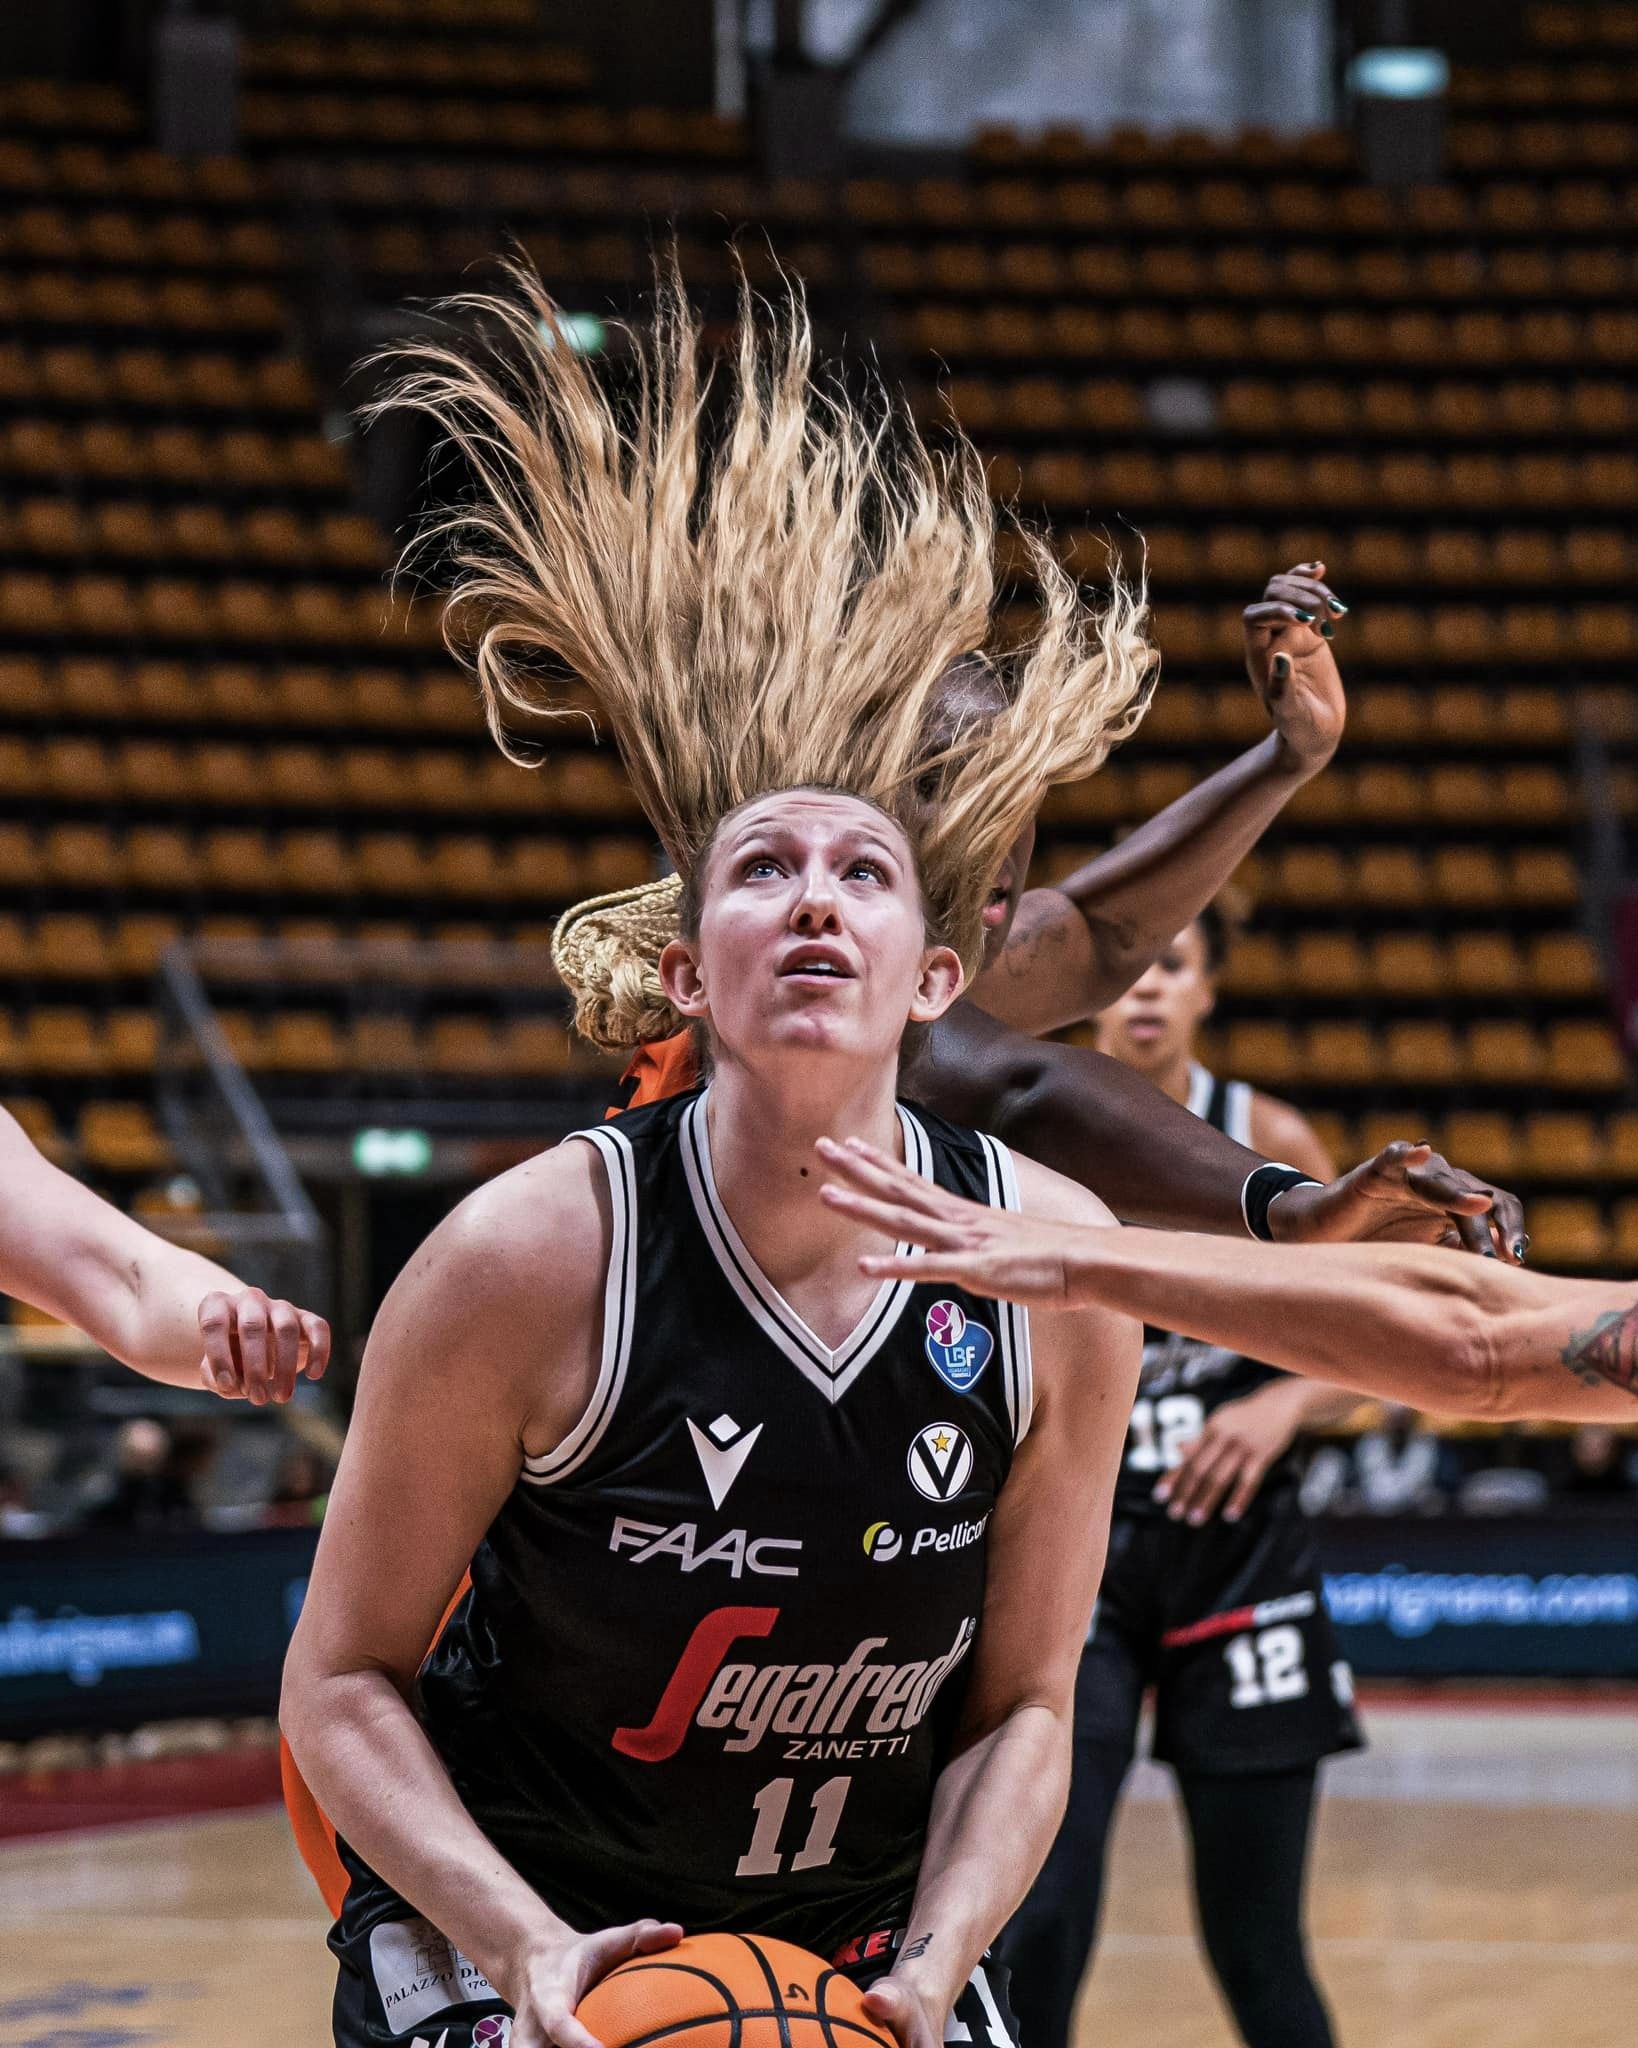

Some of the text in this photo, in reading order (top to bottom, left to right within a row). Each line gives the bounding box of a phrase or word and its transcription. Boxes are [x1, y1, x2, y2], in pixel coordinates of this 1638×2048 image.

[944, 1345, 976, 1368] LBF
[1127, 1394, 1204, 1472] 12
[608, 1516, 802, 1578] FAAC
[1224, 1624, 1309, 1709] 12
[783, 1734, 910, 1760] ZANETTI
[735, 1776, 852, 1876] 11
[385, 1972, 453, 2009] PALAZZO
[467, 1979, 493, 1992] 170
